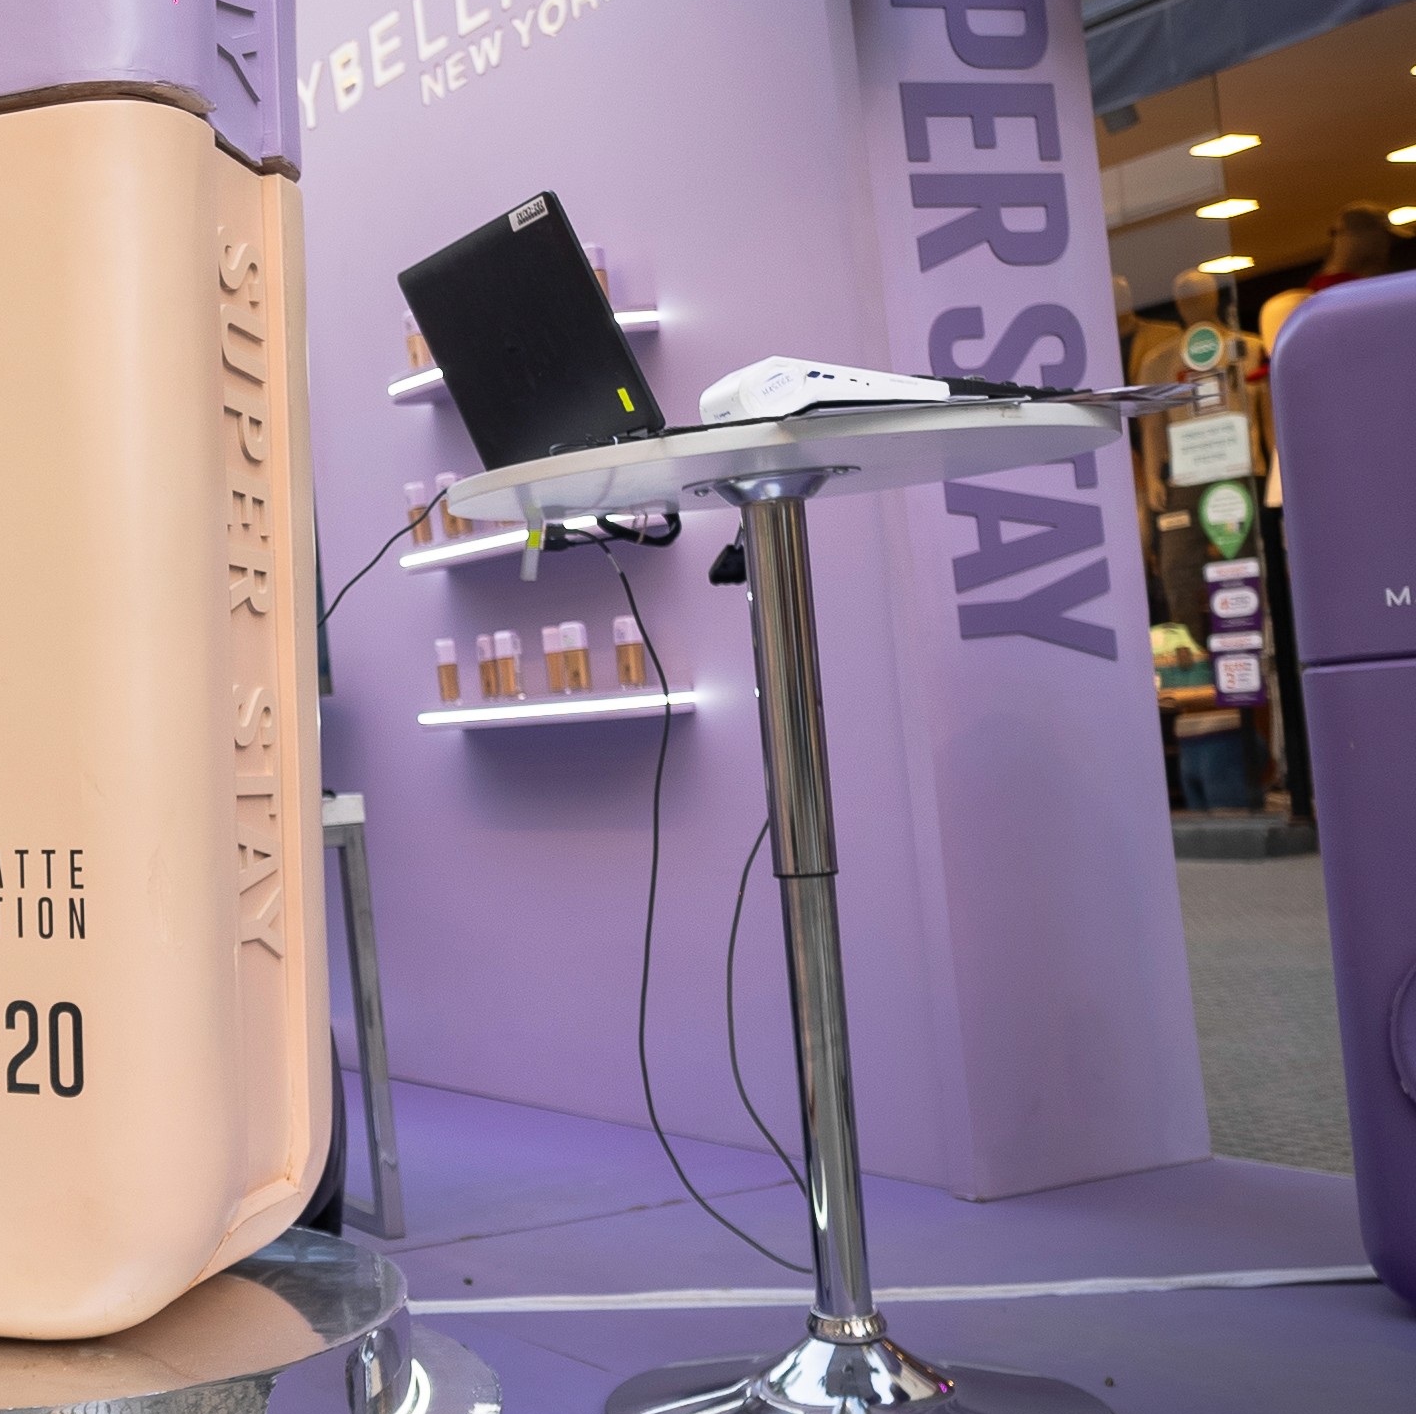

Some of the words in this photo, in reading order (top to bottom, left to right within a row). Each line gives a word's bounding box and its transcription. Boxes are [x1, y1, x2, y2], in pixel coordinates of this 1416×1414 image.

[420, 28, 504, 106] NEW
[218, 227, 270, 618] SUPER
[929, 303, 1119, 662] SAY
[1384, 585, 1416, 608] M
[233, 685, 284, 963] STAY
